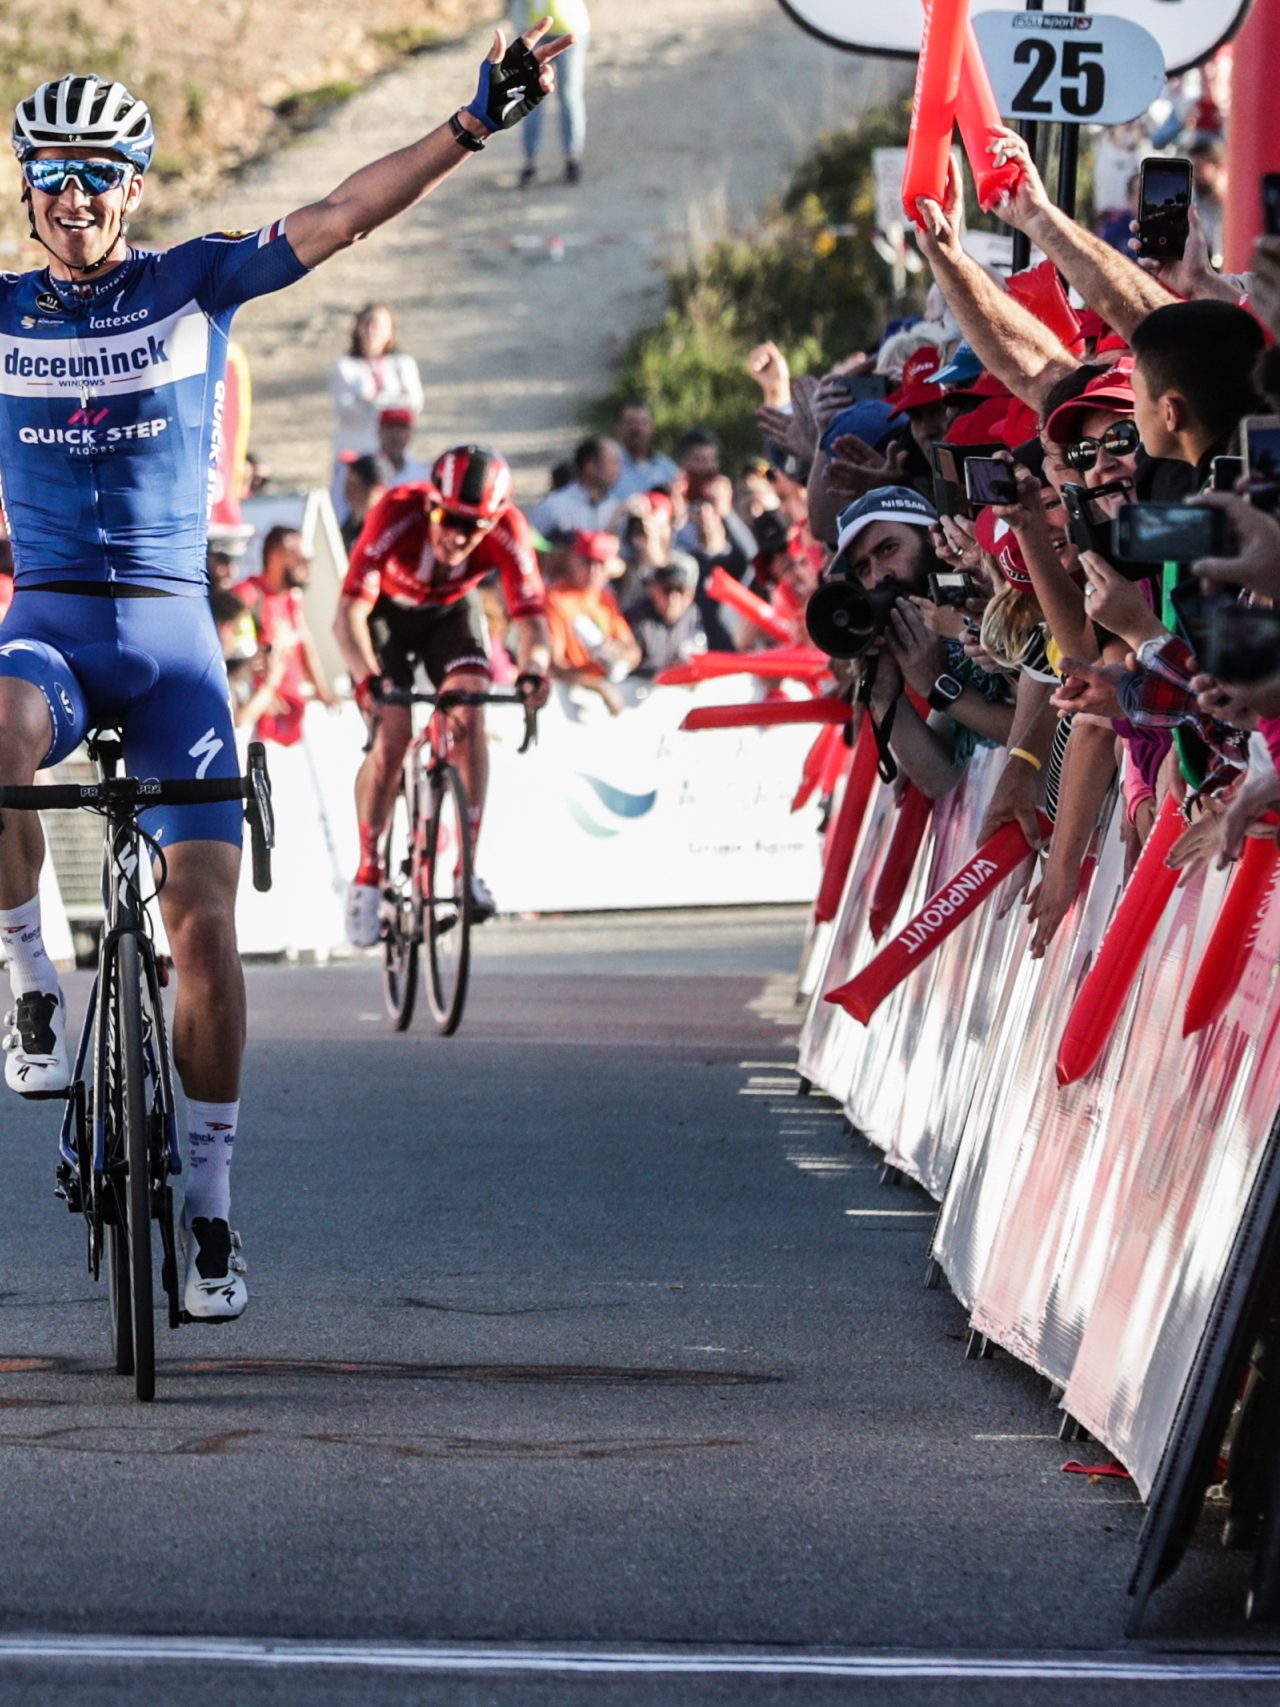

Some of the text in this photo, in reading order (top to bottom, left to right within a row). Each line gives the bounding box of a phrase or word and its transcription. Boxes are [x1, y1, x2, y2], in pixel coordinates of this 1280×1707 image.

[1011, 38, 1105, 117] 25
[89, 308, 149, 330] latexco
[4, 335, 169, 378] deceuninck
[69, 445, 116, 455] FLOORS
[881, 499, 926, 512] NISSAN
[899, 859, 999, 954] WINPROVIT
